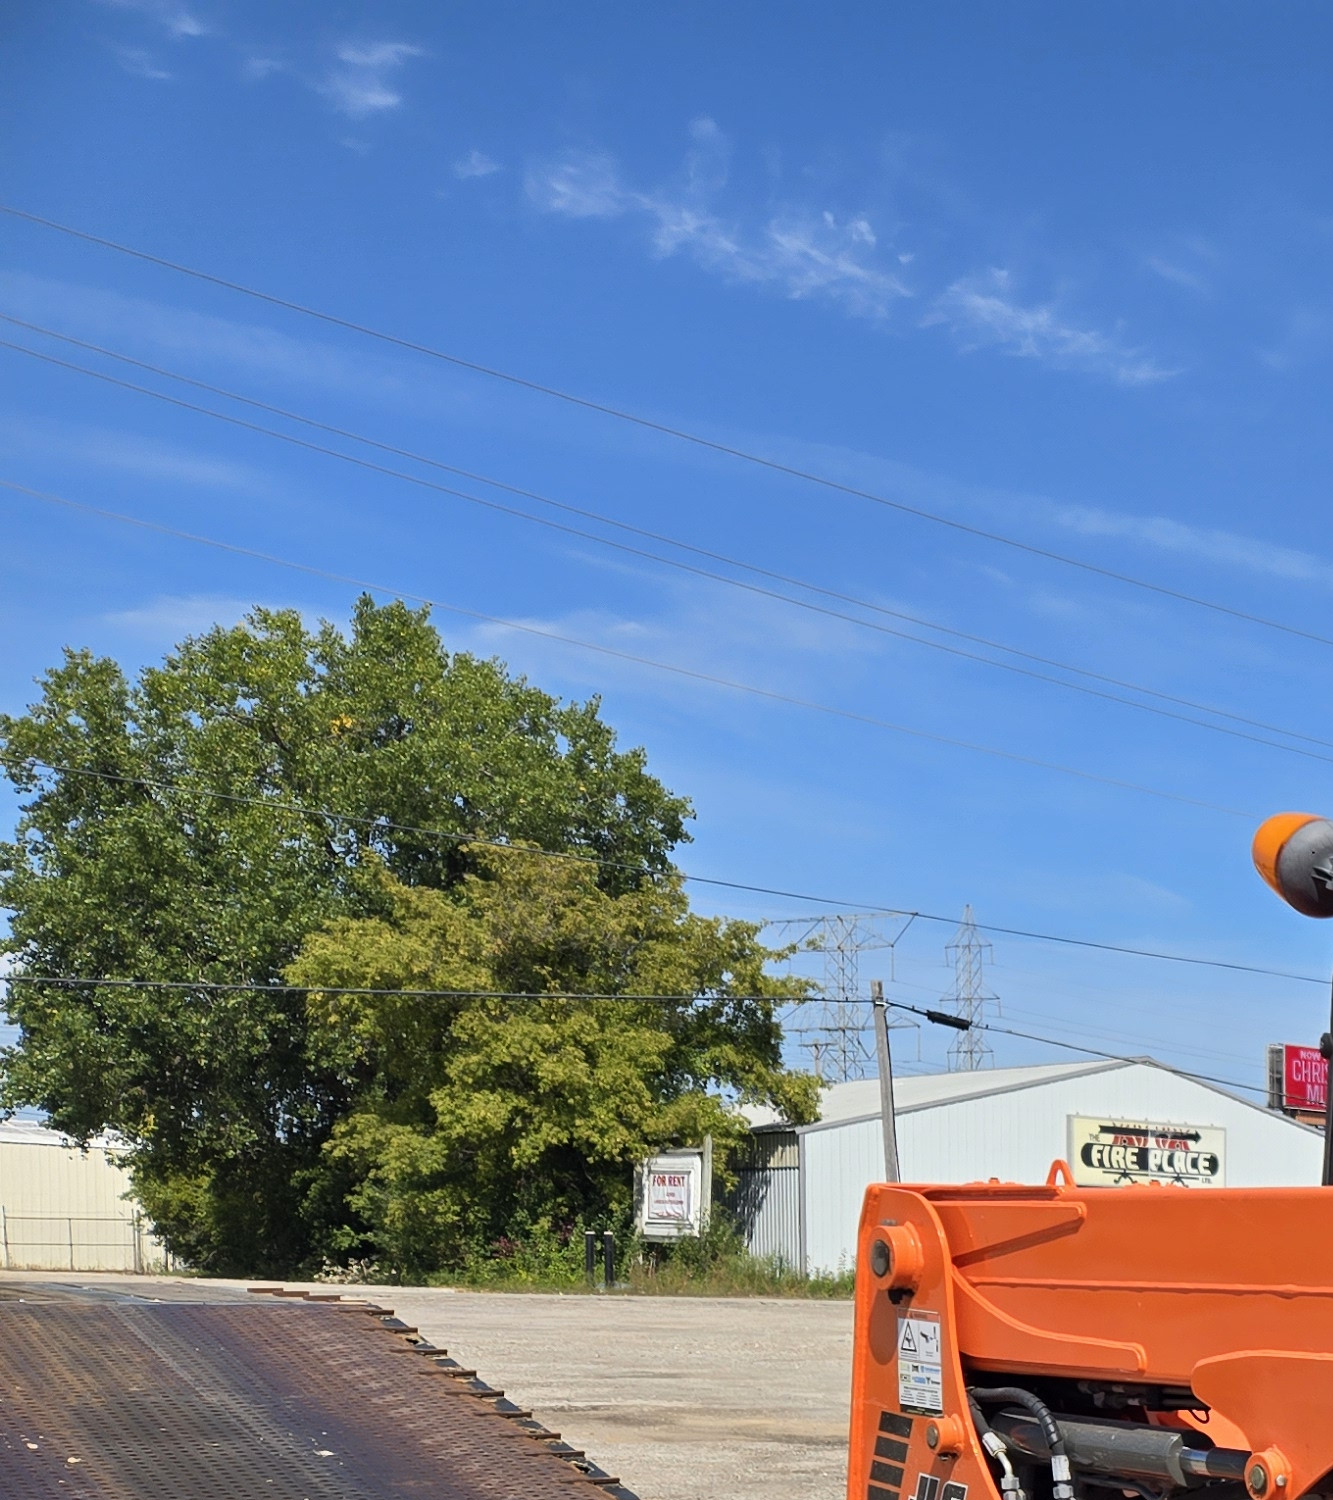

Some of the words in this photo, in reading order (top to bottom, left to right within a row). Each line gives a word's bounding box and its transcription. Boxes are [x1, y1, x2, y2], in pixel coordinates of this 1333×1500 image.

[1300, 1050, 1321, 1061] NOW
[1089, 1133, 1100, 1142] THE
[1091, 1144, 1139, 1170] FIRE
[1149, 1150, 1212, 1175] PLACE
[653, 1175, 666, 1187] FOR
[668, 1175, 685, 1187] RENT
